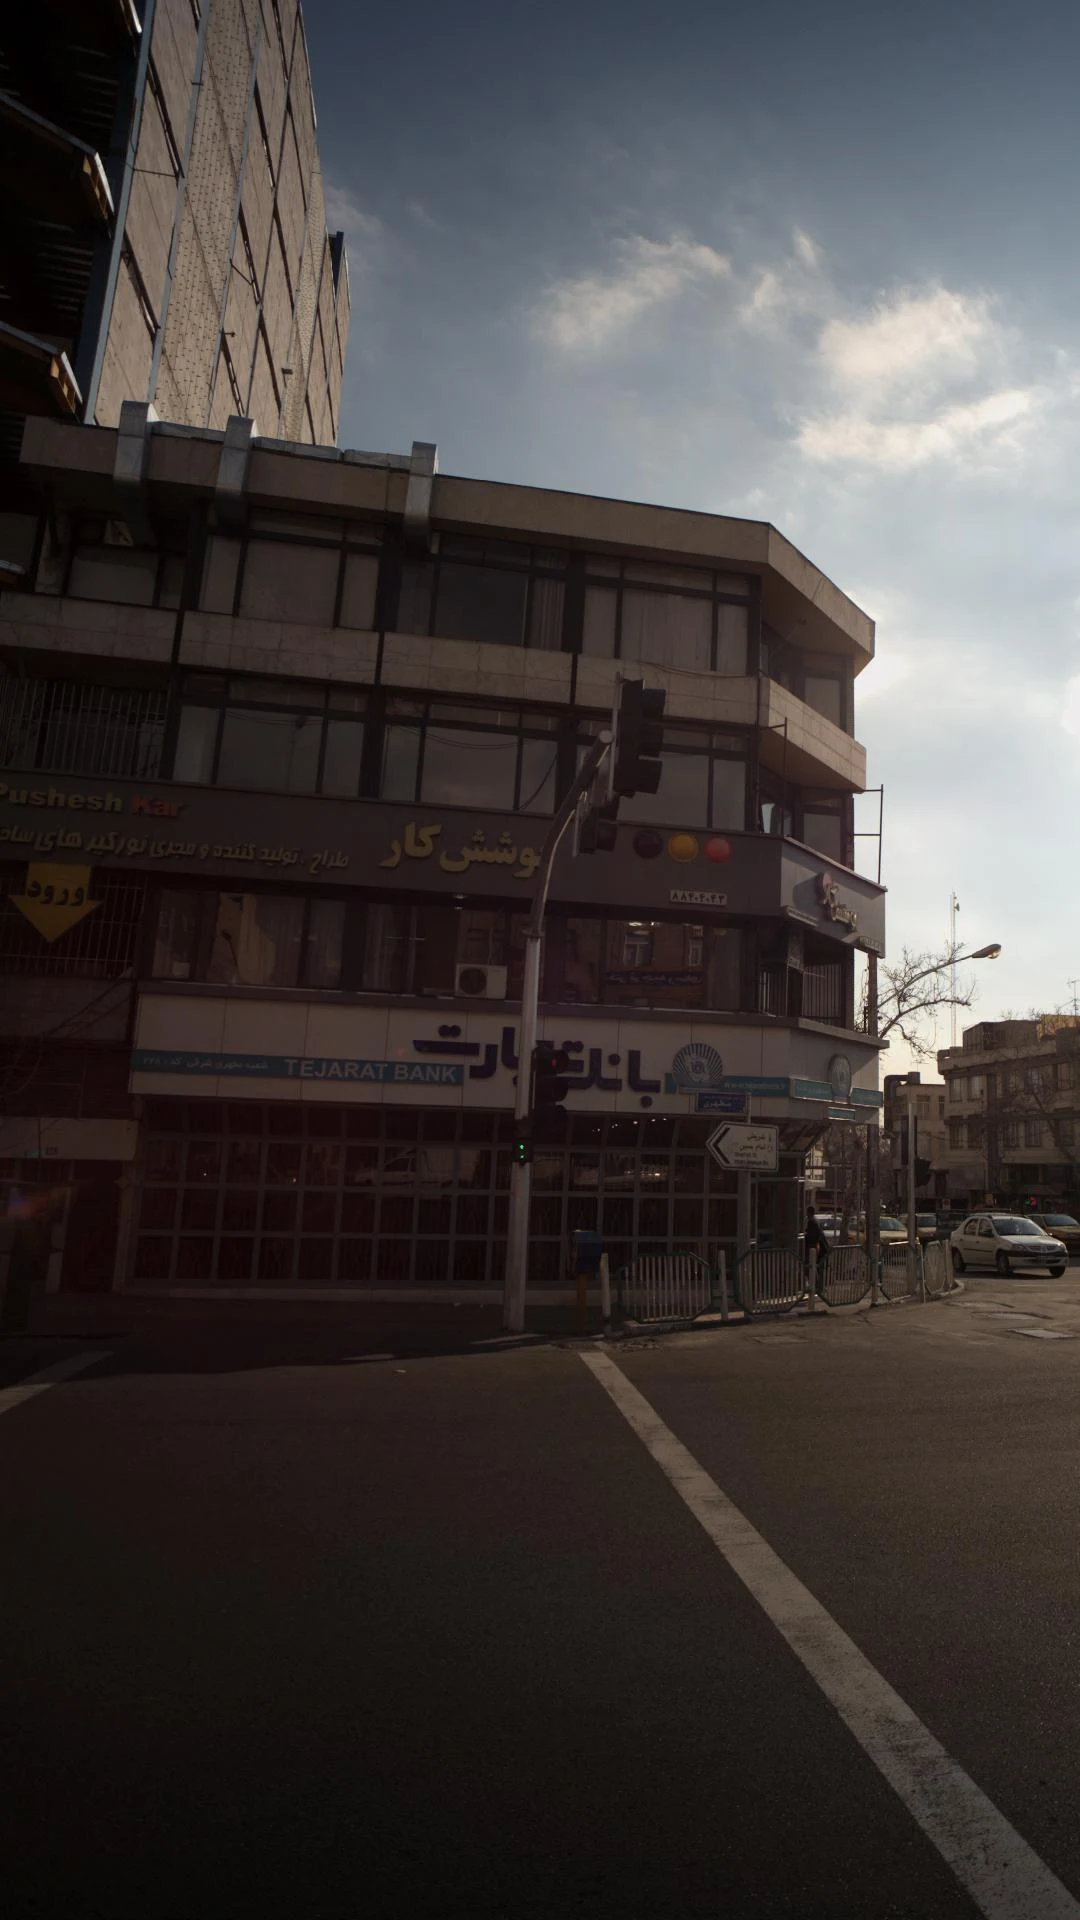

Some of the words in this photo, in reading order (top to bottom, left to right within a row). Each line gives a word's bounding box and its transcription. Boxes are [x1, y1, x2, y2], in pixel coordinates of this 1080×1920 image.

[131, 794, 181, 818] Kar
[200, 843, 210, 860] و
[213, 843, 257, 861] کننده
[259, 846, 300, 867] تولید
[378, 821, 442, 868] کار
[439, 829, 541, 879] وشش
[27, 880, 85, 906] ورود
[284, 1058, 388, 1081] TEJARAT
[394, 1064, 457, 1083] BANK
